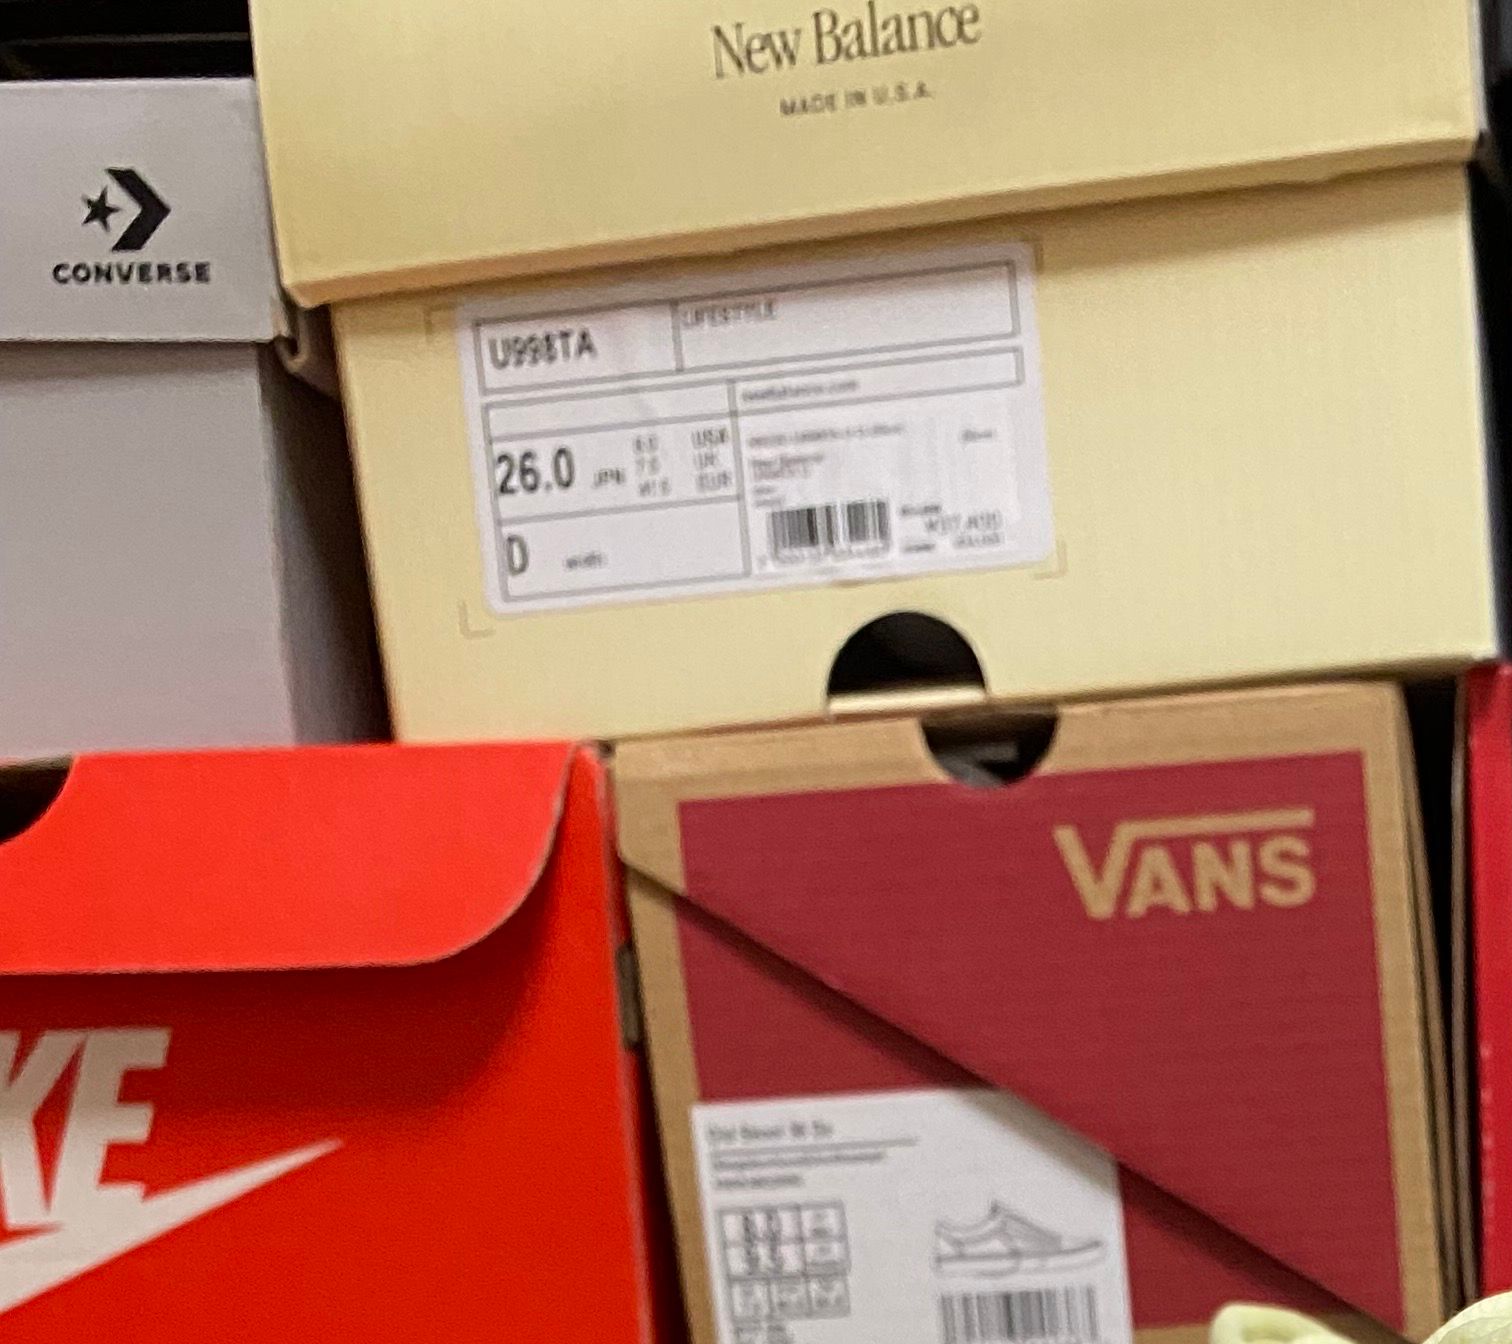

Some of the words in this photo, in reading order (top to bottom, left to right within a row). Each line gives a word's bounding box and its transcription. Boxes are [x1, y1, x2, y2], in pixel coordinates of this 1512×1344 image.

[711, 21, 802, 80] New
[811, 0, 983, 65] Balance
[779, 92, 836, 116] MADE
[52, 261, 211, 285] CONVERSE
[496, 447, 575, 495] 26.0
[1053, 805, 1316, 920] VANS
